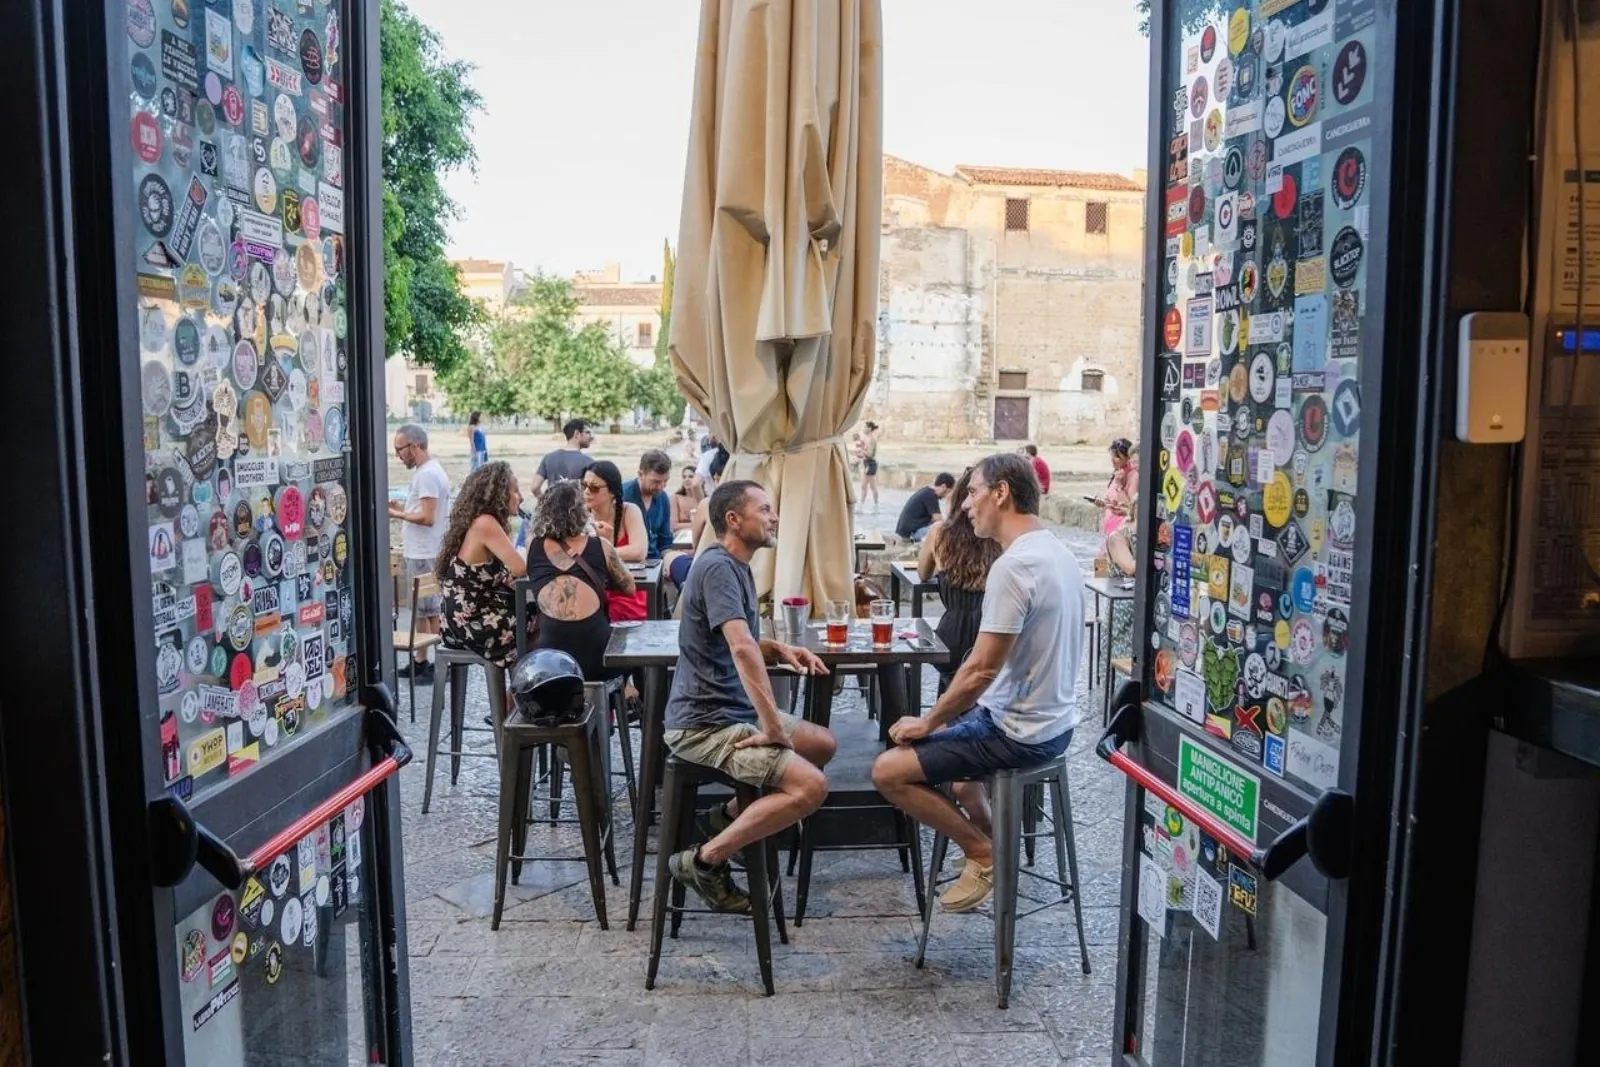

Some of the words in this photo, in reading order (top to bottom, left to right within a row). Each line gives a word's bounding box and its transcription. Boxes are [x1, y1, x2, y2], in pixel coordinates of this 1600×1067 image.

[1189, 765, 1244, 808] ANTIPANICO
[1190, 748, 1246, 794] MANIGLIONE
[1182, 777, 1216, 808] apertura
[1215, 799, 1222, 812] a
[1223, 805, 1251, 832] spinta
